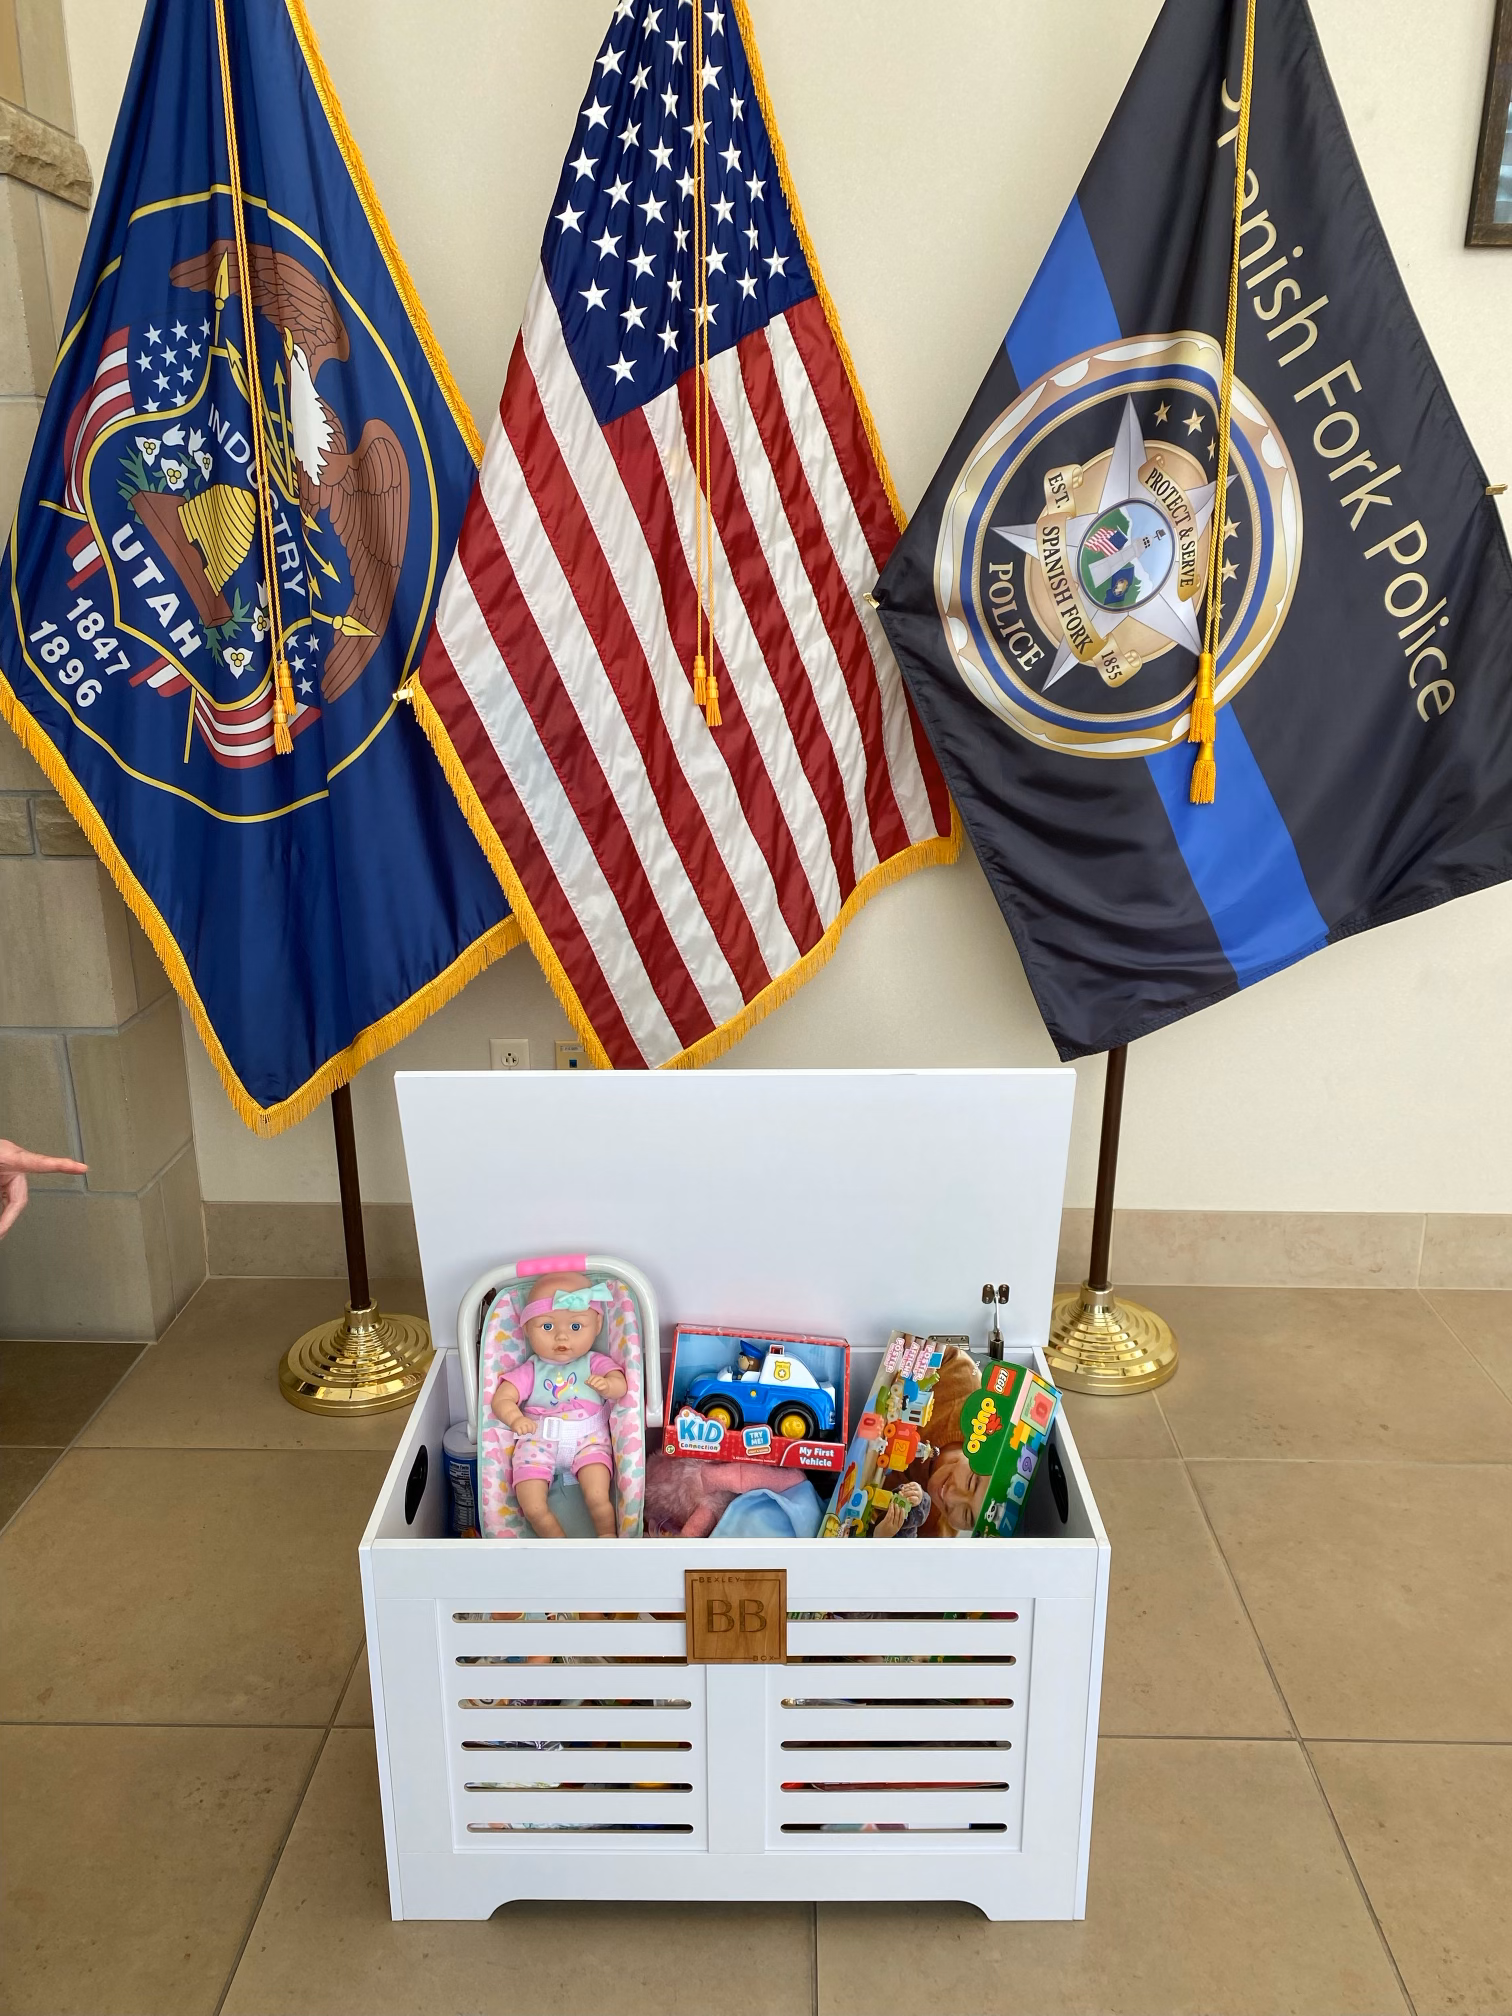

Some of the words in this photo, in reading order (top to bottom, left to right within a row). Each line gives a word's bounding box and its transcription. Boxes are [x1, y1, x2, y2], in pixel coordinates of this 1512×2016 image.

[1047, 472, 1070, 509] EST.
[1145, 467, 1192, 526] PROTECT
[1178, 526, 1194, 541] &
[1294, 359, 1401, 531] Fork
[1364, 520, 1455, 722] Police
[1179, 540, 1195, 588] SERVE
[111, 523, 202, 658] UTAH
[1042, 526, 1073, 606] SPANISH
[1061, 604, 1094, 655] FORK
[988, 562, 1045, 672] POLICE
[65, 597, 131, 676] 1847
[29, 621, 103, 707] 1896
[1101, 649, 1123, 681] 1855
[994, 1368, 1008, 1394] LEGO
[680, 1419, 722, 1442] KID
[749, 1431, 763, 1439] TRY
[967, 1397, 996, 1453] duplo
[680, 1442, 718, 1451] Connection
[799, 1446, 812, 1457] My
[814, 1447, 834, 1457] First
[800, 1456, 832, 1467] Vehicle
[706, 1599, 767, 1633] BB
